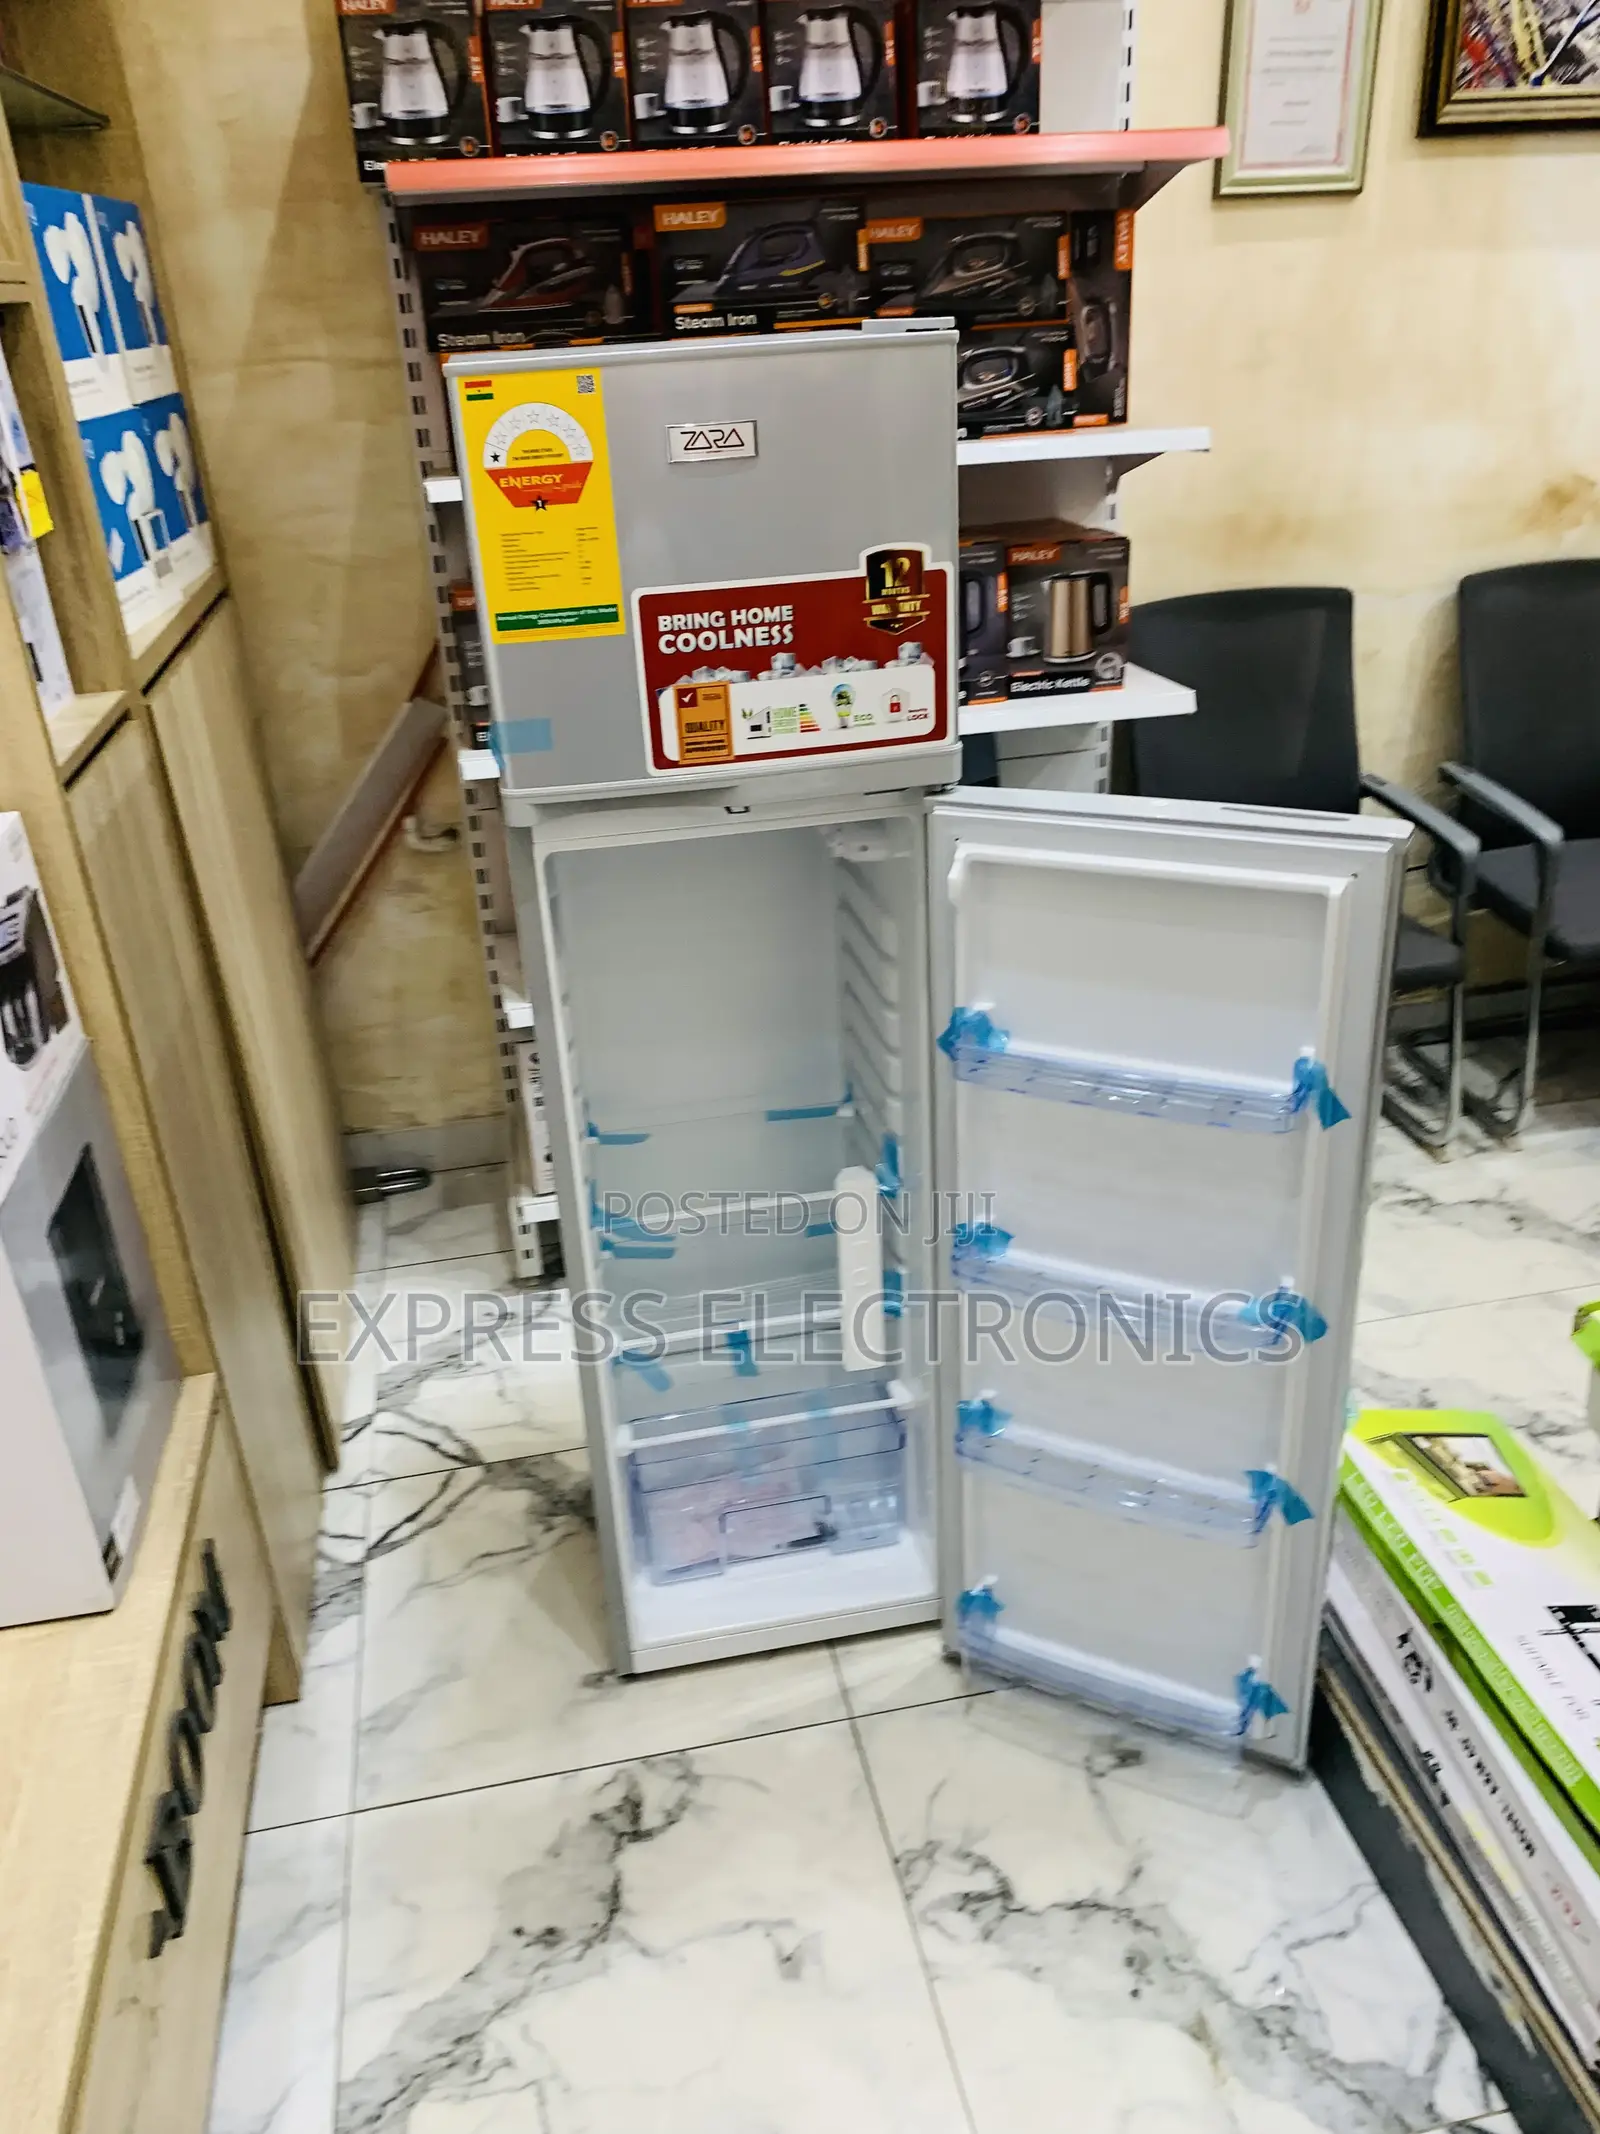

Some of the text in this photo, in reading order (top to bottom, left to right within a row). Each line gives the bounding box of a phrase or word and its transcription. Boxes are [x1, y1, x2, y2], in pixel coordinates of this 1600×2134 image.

[662, 207, 721, 225] HALEY
[420, 229, 480, 245] HALEY
[869, 224, 920, 239] HALEY
[674, 313, 757, 330] Steam Iron
[437, 331, 526, 348] Steam Iron
[680, 428, 745, 451] ZARA
[499, 473, 565, 489] ENERGY
[880, 557, 911, 587] 12
[657, 604, 794, 632] BRING HOME
[658, 623, 794, 654] COOLNESS
